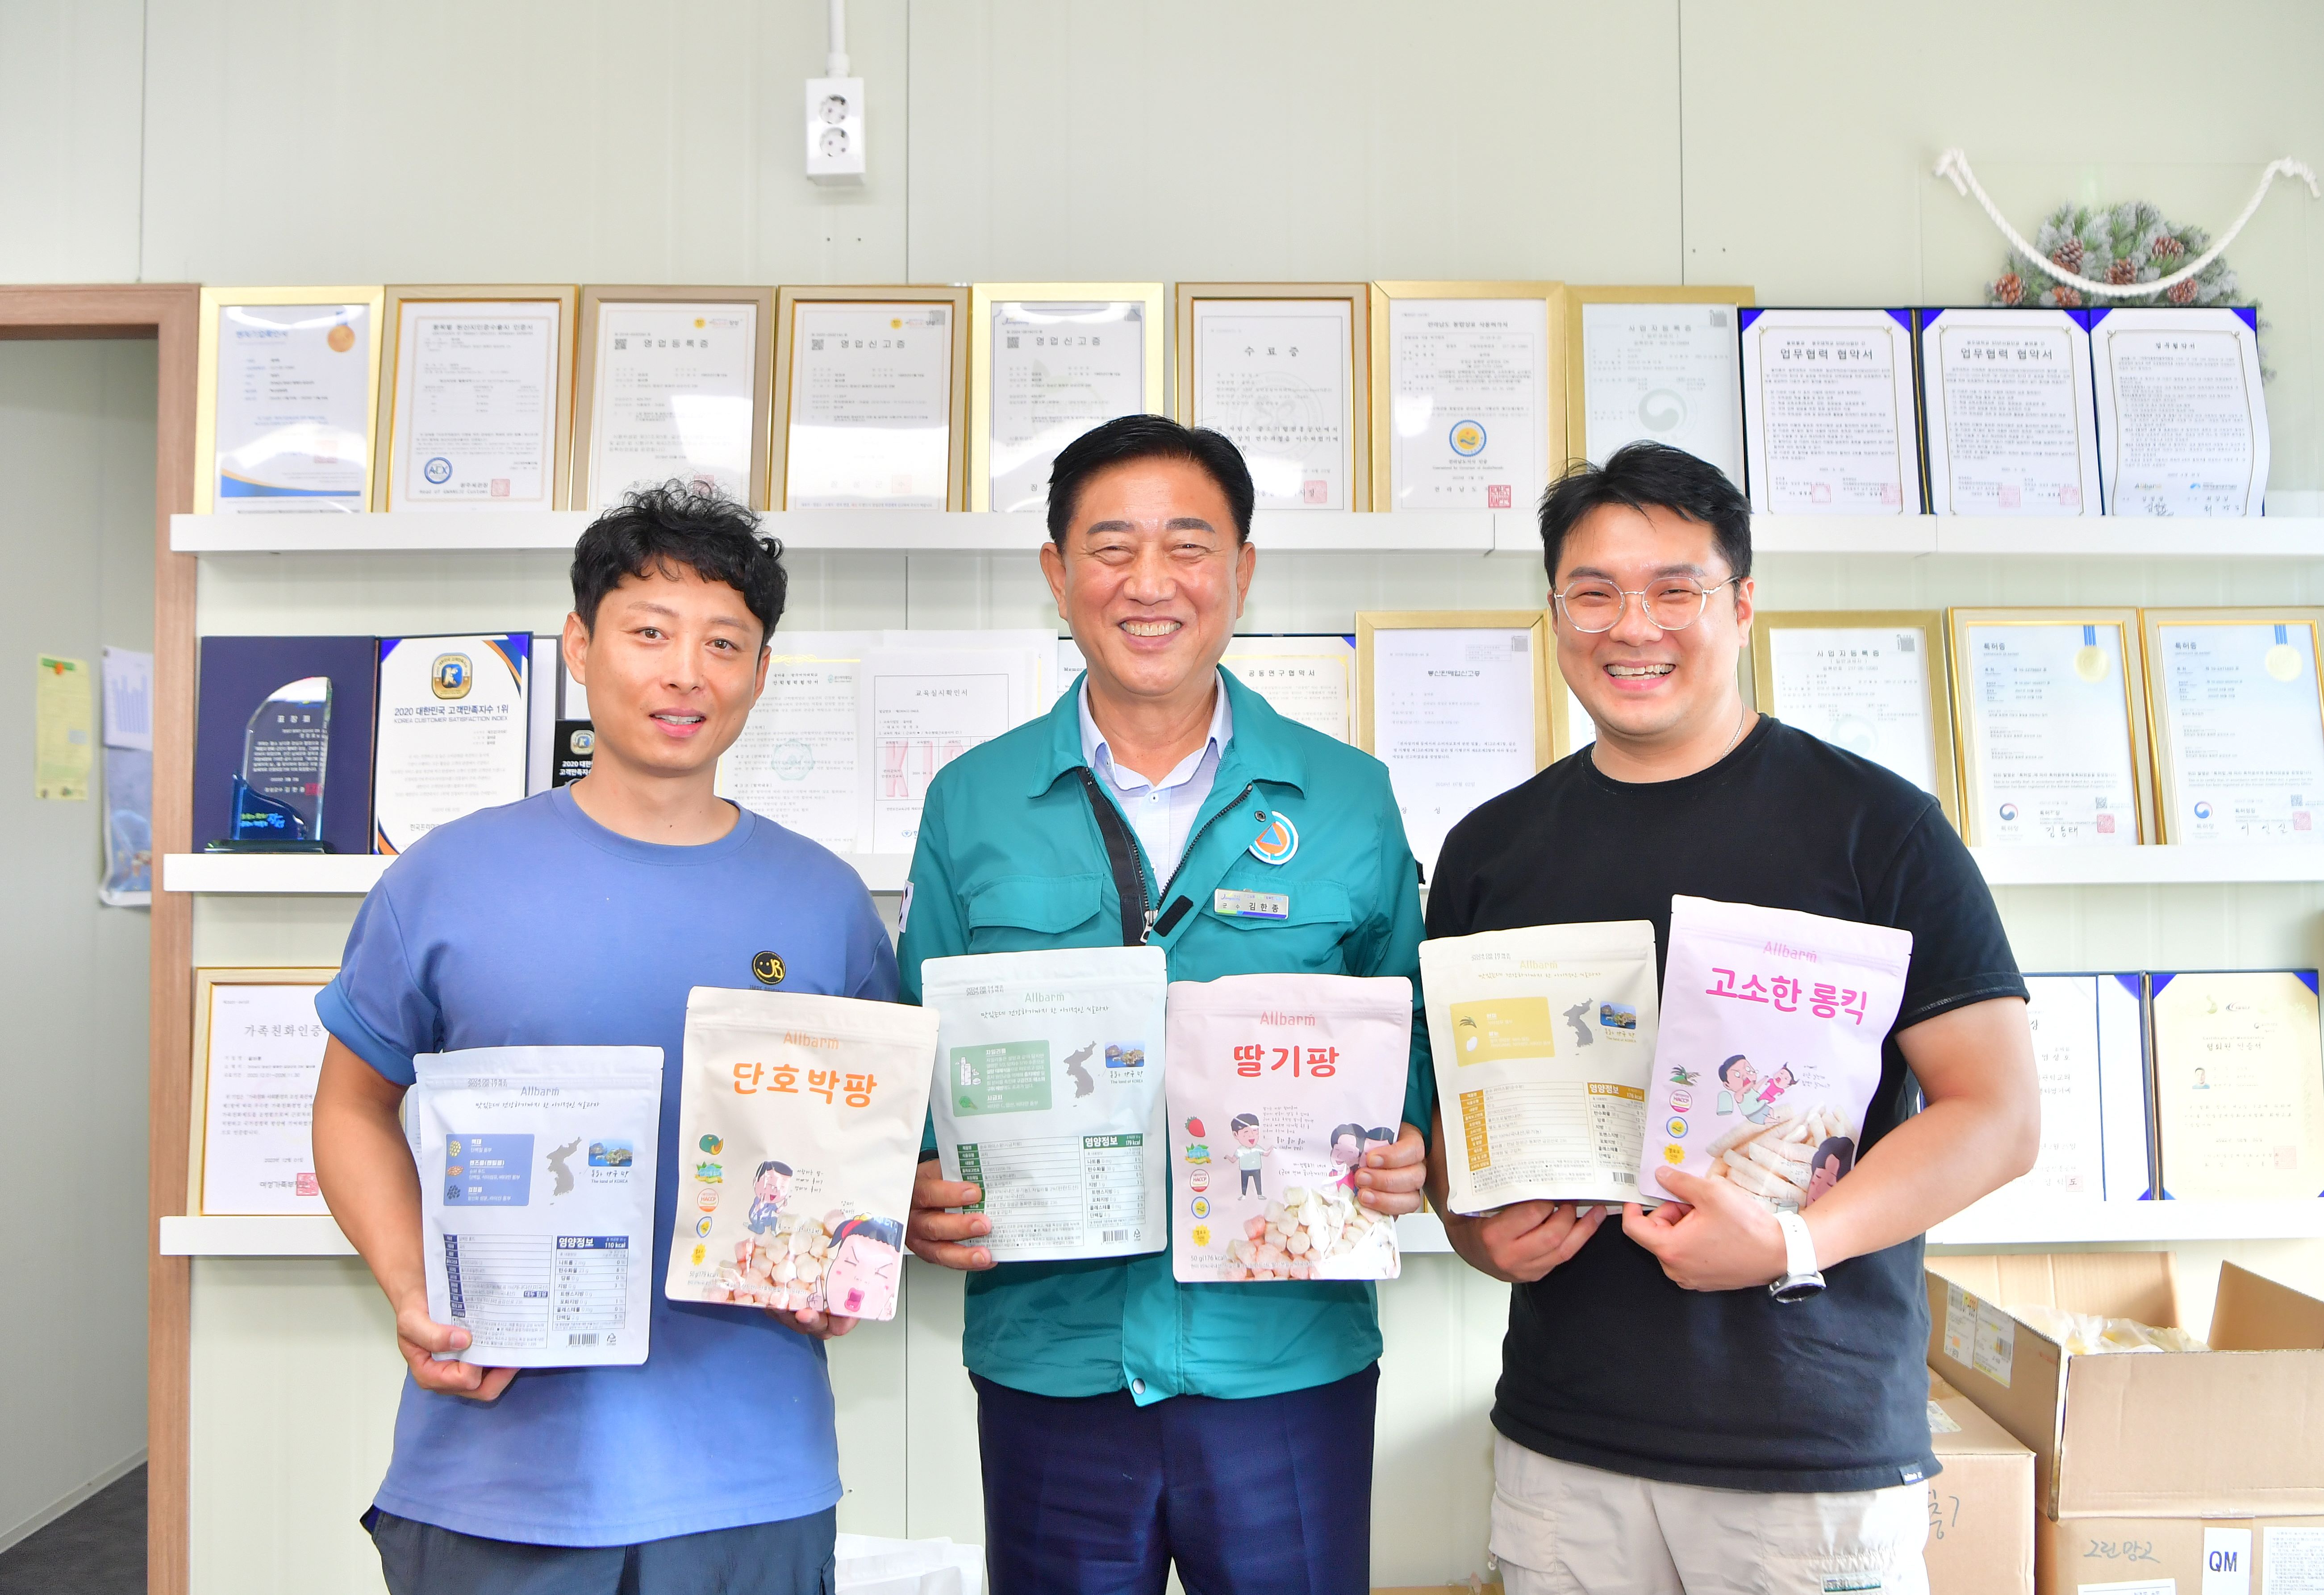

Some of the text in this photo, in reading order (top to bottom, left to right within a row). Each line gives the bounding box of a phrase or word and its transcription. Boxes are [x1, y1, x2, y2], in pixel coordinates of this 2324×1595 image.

[1780, 348, 1873, 360] 업무협력 협약서
[1961, 347, 2053, 360] 업무협력 협약서
[1984, 642, 2006, 650] 특허증
[2175, 642, 2197, 650] 특허증
[395, 704, 509, 716] 2020 대한민국 고객만족지수 1위
[1248, 902, 1279, 913] 김한종
[1763, 940, 1817, 963] Allbarm
[1519, 960, 1558, 969] Allbarm
[1025, 992, 1065, 1003] Allbarm
[1706, 967, 1867, 1026] 고소한 롱킥
[1260, 1010, 1316, 1026] Allbarm
[783, 1031, 840, 1050] Allbarm
[1233, 1044, 1339, 1078] 딸기팡
[733, 1062, 878, 1108] 단호박팡
[1590, 1084, 1619, 1094] 영양정보
[521, 1086, 560, 1097] Allbarm
[1085, 1136, 1118, 1147] 영양정보
[559, 1237, 594, 1248] 영양정보
[2209, 1550, 2238, 1572] QM
